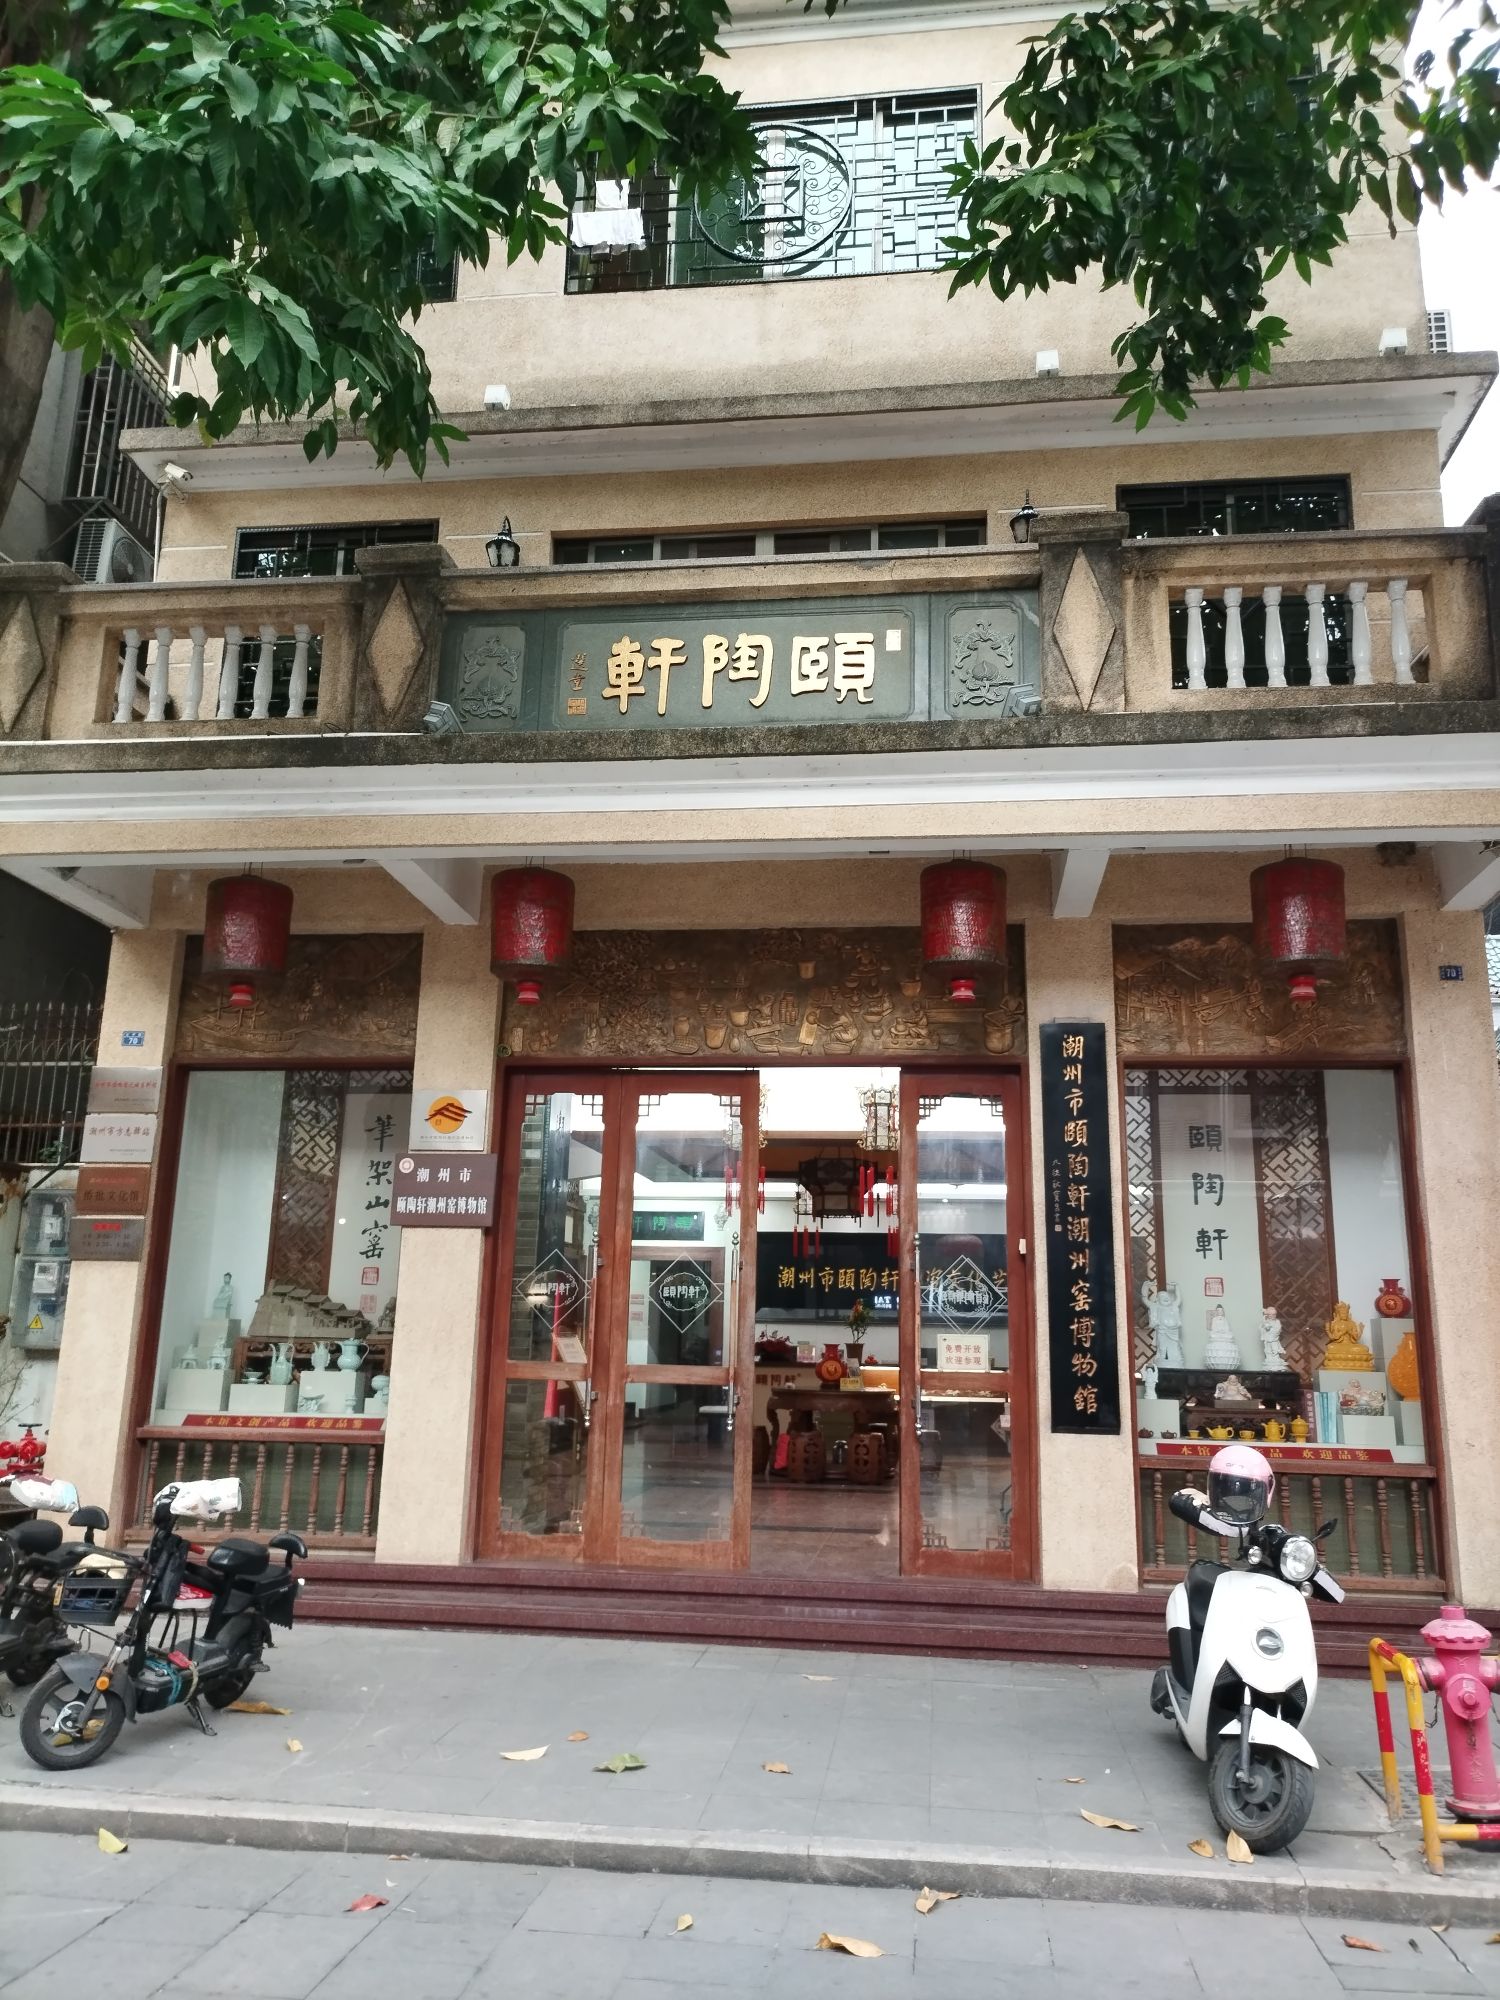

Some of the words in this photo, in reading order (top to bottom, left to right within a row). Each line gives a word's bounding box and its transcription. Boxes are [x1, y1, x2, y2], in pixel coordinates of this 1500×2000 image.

[1446, 968, 1456, 977] 70
[128, 1037, 138, 1045] 70
[416, 1167, 472, 1183] 潮州市
[396, 1196, 488, 1214] 颐陶轩潮州窑博物馆
